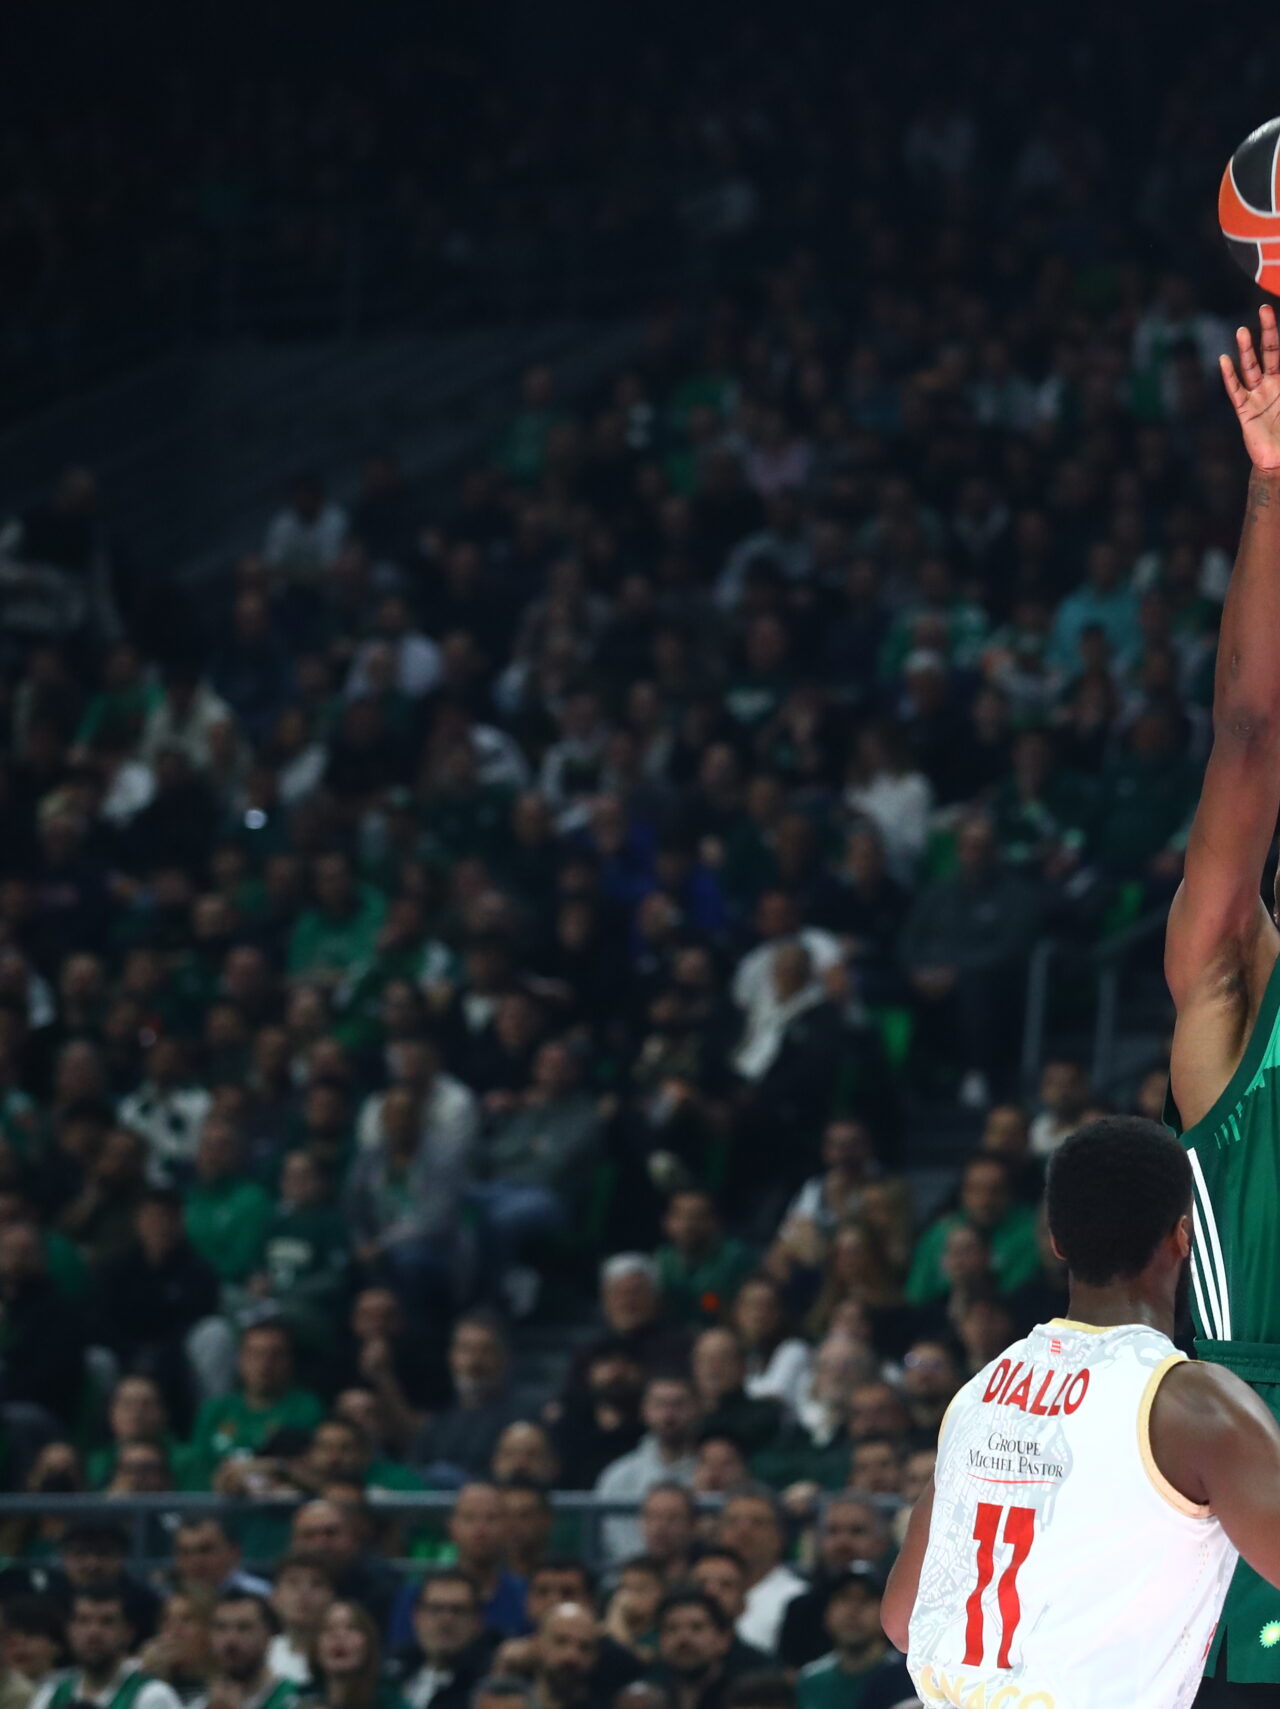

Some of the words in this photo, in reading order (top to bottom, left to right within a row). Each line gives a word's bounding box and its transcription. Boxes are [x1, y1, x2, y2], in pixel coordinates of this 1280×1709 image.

[982, 1358, 1090, 1417] DIALLO
[966, 1448, 1014, 1473] MICHEL
[1017, 1455, 1063, 1478] PASTOR
[961, 1501, 1037, 1669] 11
